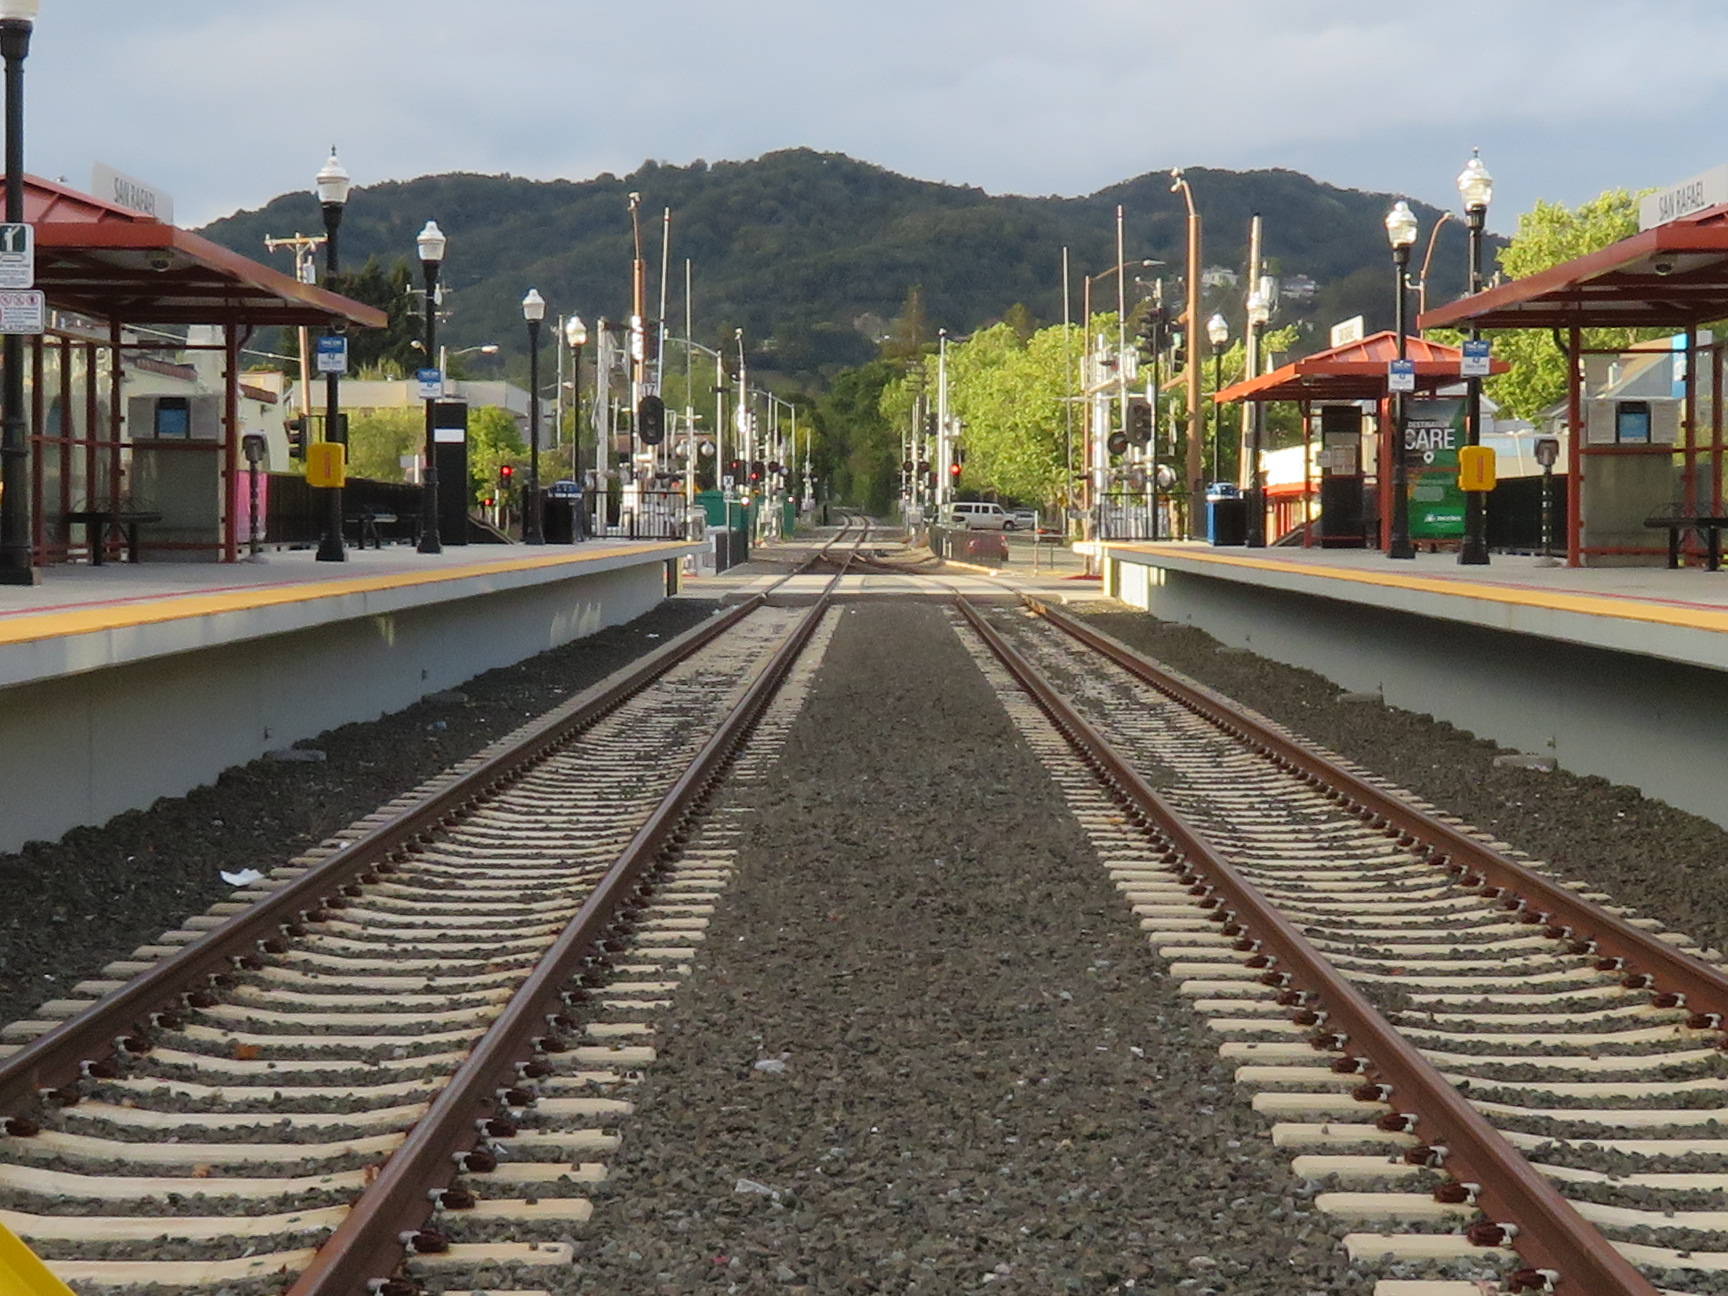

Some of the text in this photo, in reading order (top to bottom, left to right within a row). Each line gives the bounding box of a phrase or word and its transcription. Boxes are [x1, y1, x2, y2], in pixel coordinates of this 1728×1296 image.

[1659, 181, 1705, 221] SAN RAFAEL
[1405, 428, 1456, 450] CARE
